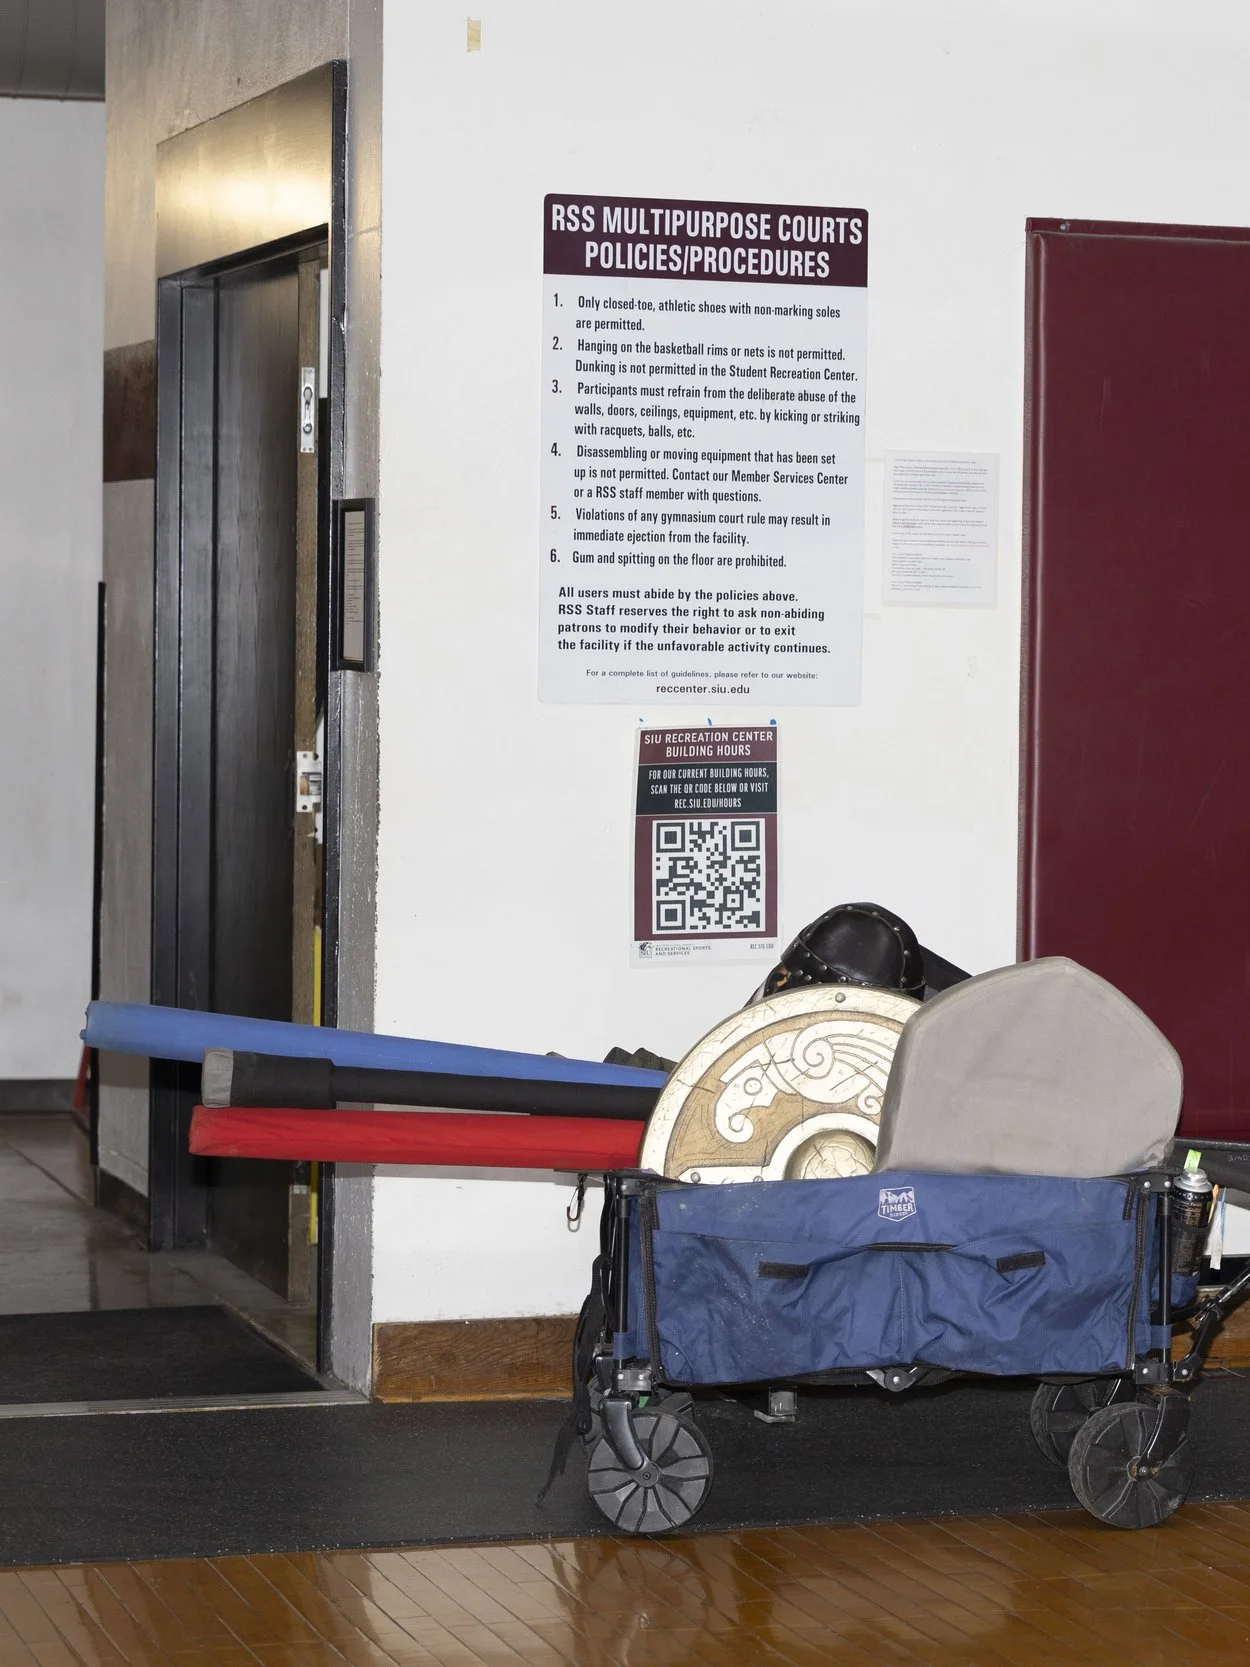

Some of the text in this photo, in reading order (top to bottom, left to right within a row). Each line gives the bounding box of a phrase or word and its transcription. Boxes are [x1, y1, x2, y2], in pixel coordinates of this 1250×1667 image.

[552, 204, 862, 244] RSS MULTIPURPOSE COURTS
[585, 241, 829, 278] POLICIES/PROCEDURES
[554, 293, 840, 320] 1. Only closed-toe, athletic shoes with non-marking soles
[552, 336, 845, 362] 2. Hanging on the basketball rims or nets is not permitted.
[552, 379, 856, 403] 3. Participants must refrain from the deliberate abuse of the
[574, 403, 860, 426] walls, doors, ceilings, equipment, etc. by kicking or striking
[574, 422, 695, 439] with racquets, balls, etc.
[550, 442, 835, 464] 4. Disassembling or moving equipment that has been set
[574, 485, 761, 504] or a RSS staff member with questions.
[550, 505, 830, 527] 5. Violations of any gymnasium court rule may result in
[573, 528, 749, 547] immediate ejection from the facility.
[550, 548, 786, 569] 6. Gum and spitting on the floor are prohibited.
[558, 586, 798, 602] All users must abide by the policies above.
[558, 604, 824, 621] RSS Staff reserves the right to ask non-abiding
[557, 639, 830, 655] the facility if the unfavorable activity continues.
[608, 670, 644, 678] complete
[671, 670, 711, 678] guidelines,
[714, 671, 738, 679] please
[656, 684, 750, 694] reccenter.siu.edu
[644, 731, 773, 744] SIU RECREATION CENTER
[666, 744, 750, 757] BUILDING HOURS
[649, 767, 769, 779] FOR OUR CURRENT BUILDING HOURS,
[651, 784, 667, 794] SCAN
[670, 784, 681, 793] THE
[695, 783, 711, 793] CODE
[714, 783, 737, 793] BELOW
[739, 782, 748, 792] OR
[750, 782, 768, 792] VISIT
[880, 1203, 914, 1215] TIMBER
